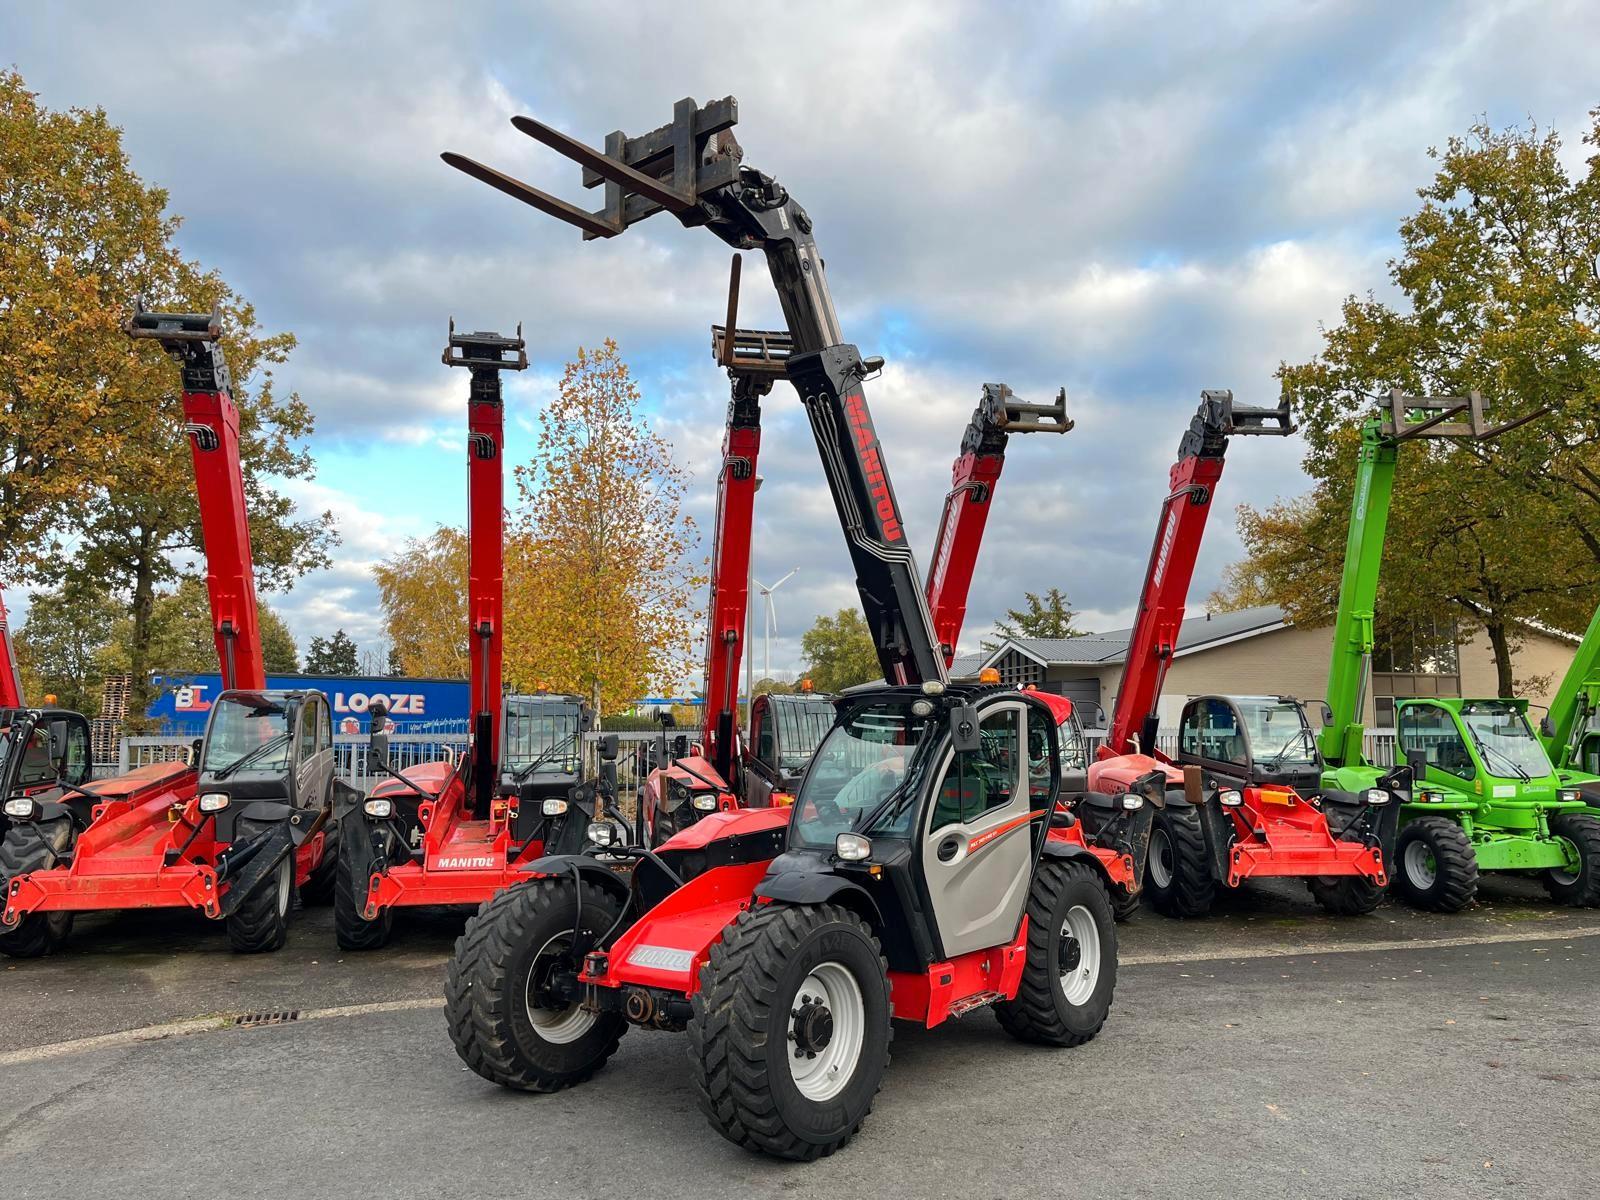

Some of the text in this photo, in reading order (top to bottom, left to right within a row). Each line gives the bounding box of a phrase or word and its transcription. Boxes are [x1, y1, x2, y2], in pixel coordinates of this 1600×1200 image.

[846, 394, 902, 543] MANITOU
[933, 499, 960, 590] MANITOU
[1153, 509, 1177, 589] MANITOU
[334, 692, 425, 715] LOOZE
[438, 857, 495, 868] MANITOU
